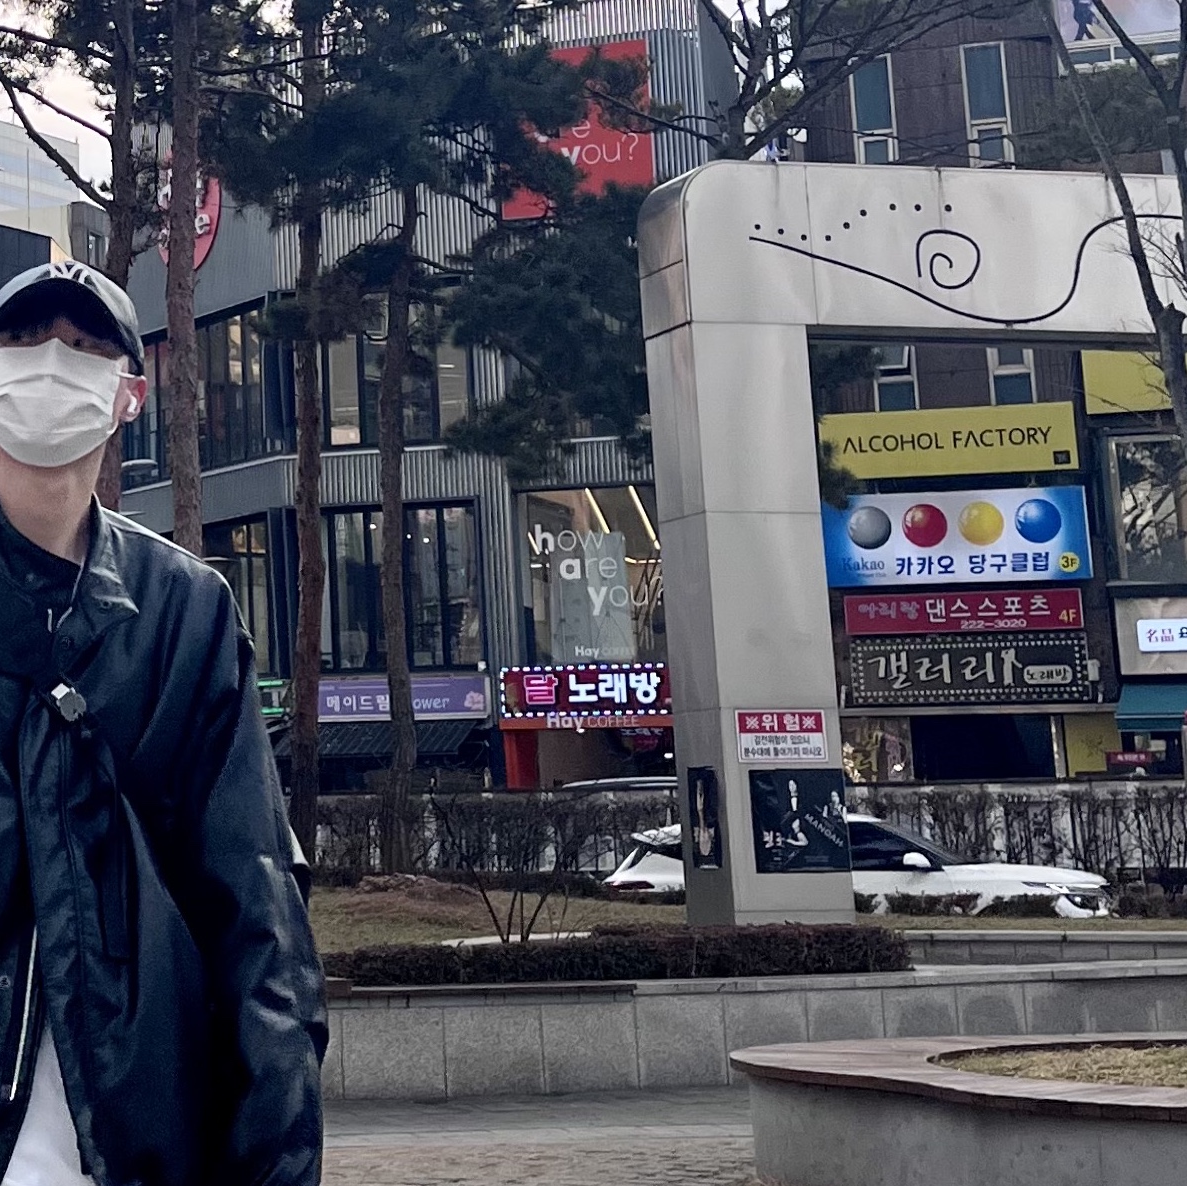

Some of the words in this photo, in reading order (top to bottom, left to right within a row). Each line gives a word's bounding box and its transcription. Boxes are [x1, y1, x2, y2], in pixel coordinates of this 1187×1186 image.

[843, 431, 945, 455] ALCOHOL
[952, 426, 1052, 449] FACTORY
[534, 524, 604, 552] how
[559, 557, 618, 580] are
[842, 557, 885, 571] Kakao
[895, 555, 956, 576] 카카오
[968, 551, 1051, 574] 당구클럽
[1061, 556, 1079, 568] 3F
[960, 618, 1027, 630] 222-3020
[1059, 608, 1077, 623] 4F
[575, 646, 600, 659] Hay
[867, 650, 996, 690] 갤러리
[1026, 666, 1069, 682] 노래방
[568, 672, 661, 704] 노래방
[413, 696, 450, 711] ower
[546, 712, 584, 733] Hay
[587, 715, 639, 727] COFFEE
